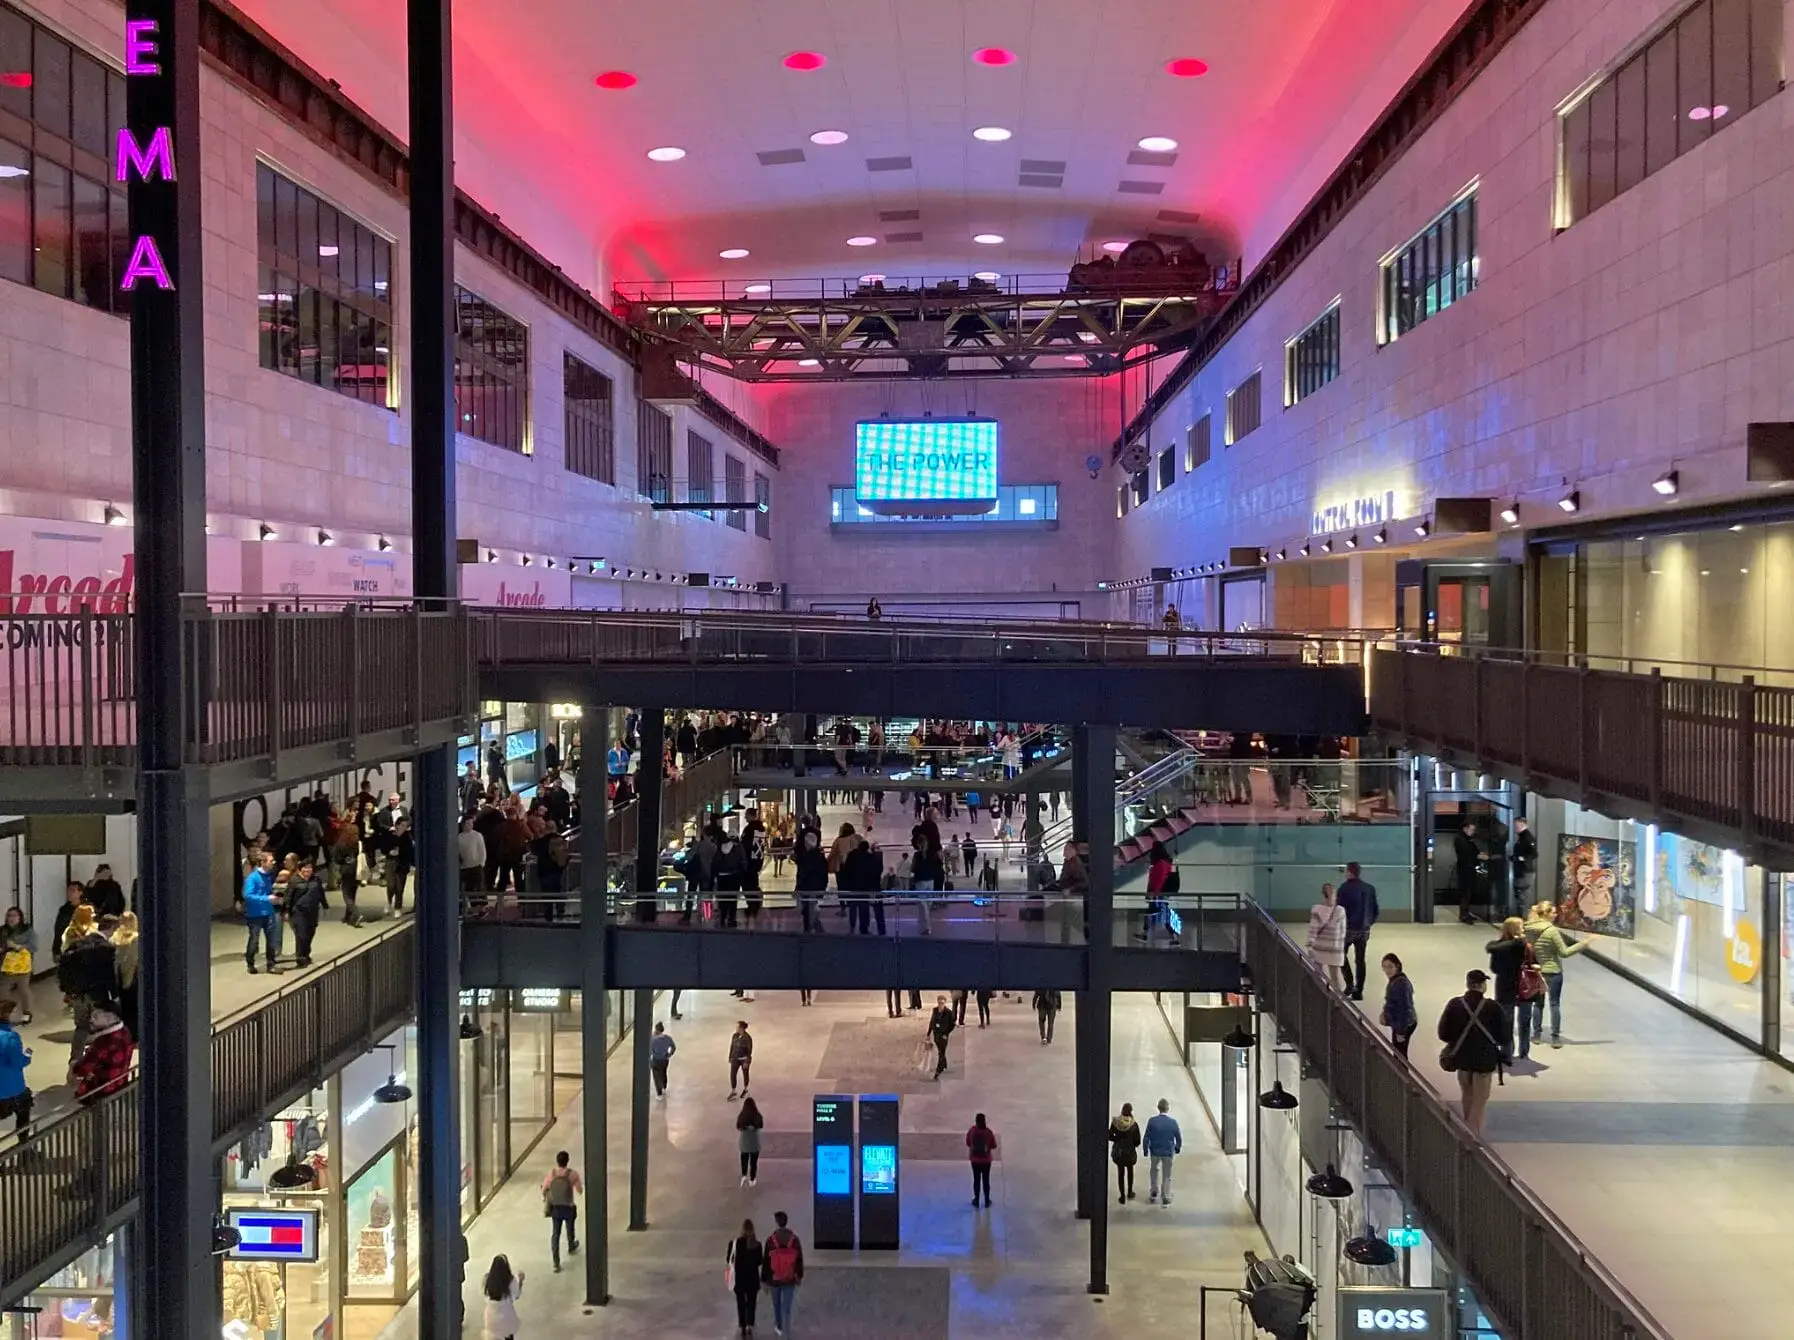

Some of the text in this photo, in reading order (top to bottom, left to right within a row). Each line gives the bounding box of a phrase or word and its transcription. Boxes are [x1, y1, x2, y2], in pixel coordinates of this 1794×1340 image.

[867, 452, 988, 471] THE POWER
[353, 579, 379, 593] WATCH
[496, 581, 545, 606] Arcade
[0, 622, 84, 650] OMIN
[524, 997, 559, 1007] STUDIO
[1357, 1308, 1428, 1330] BOSS
